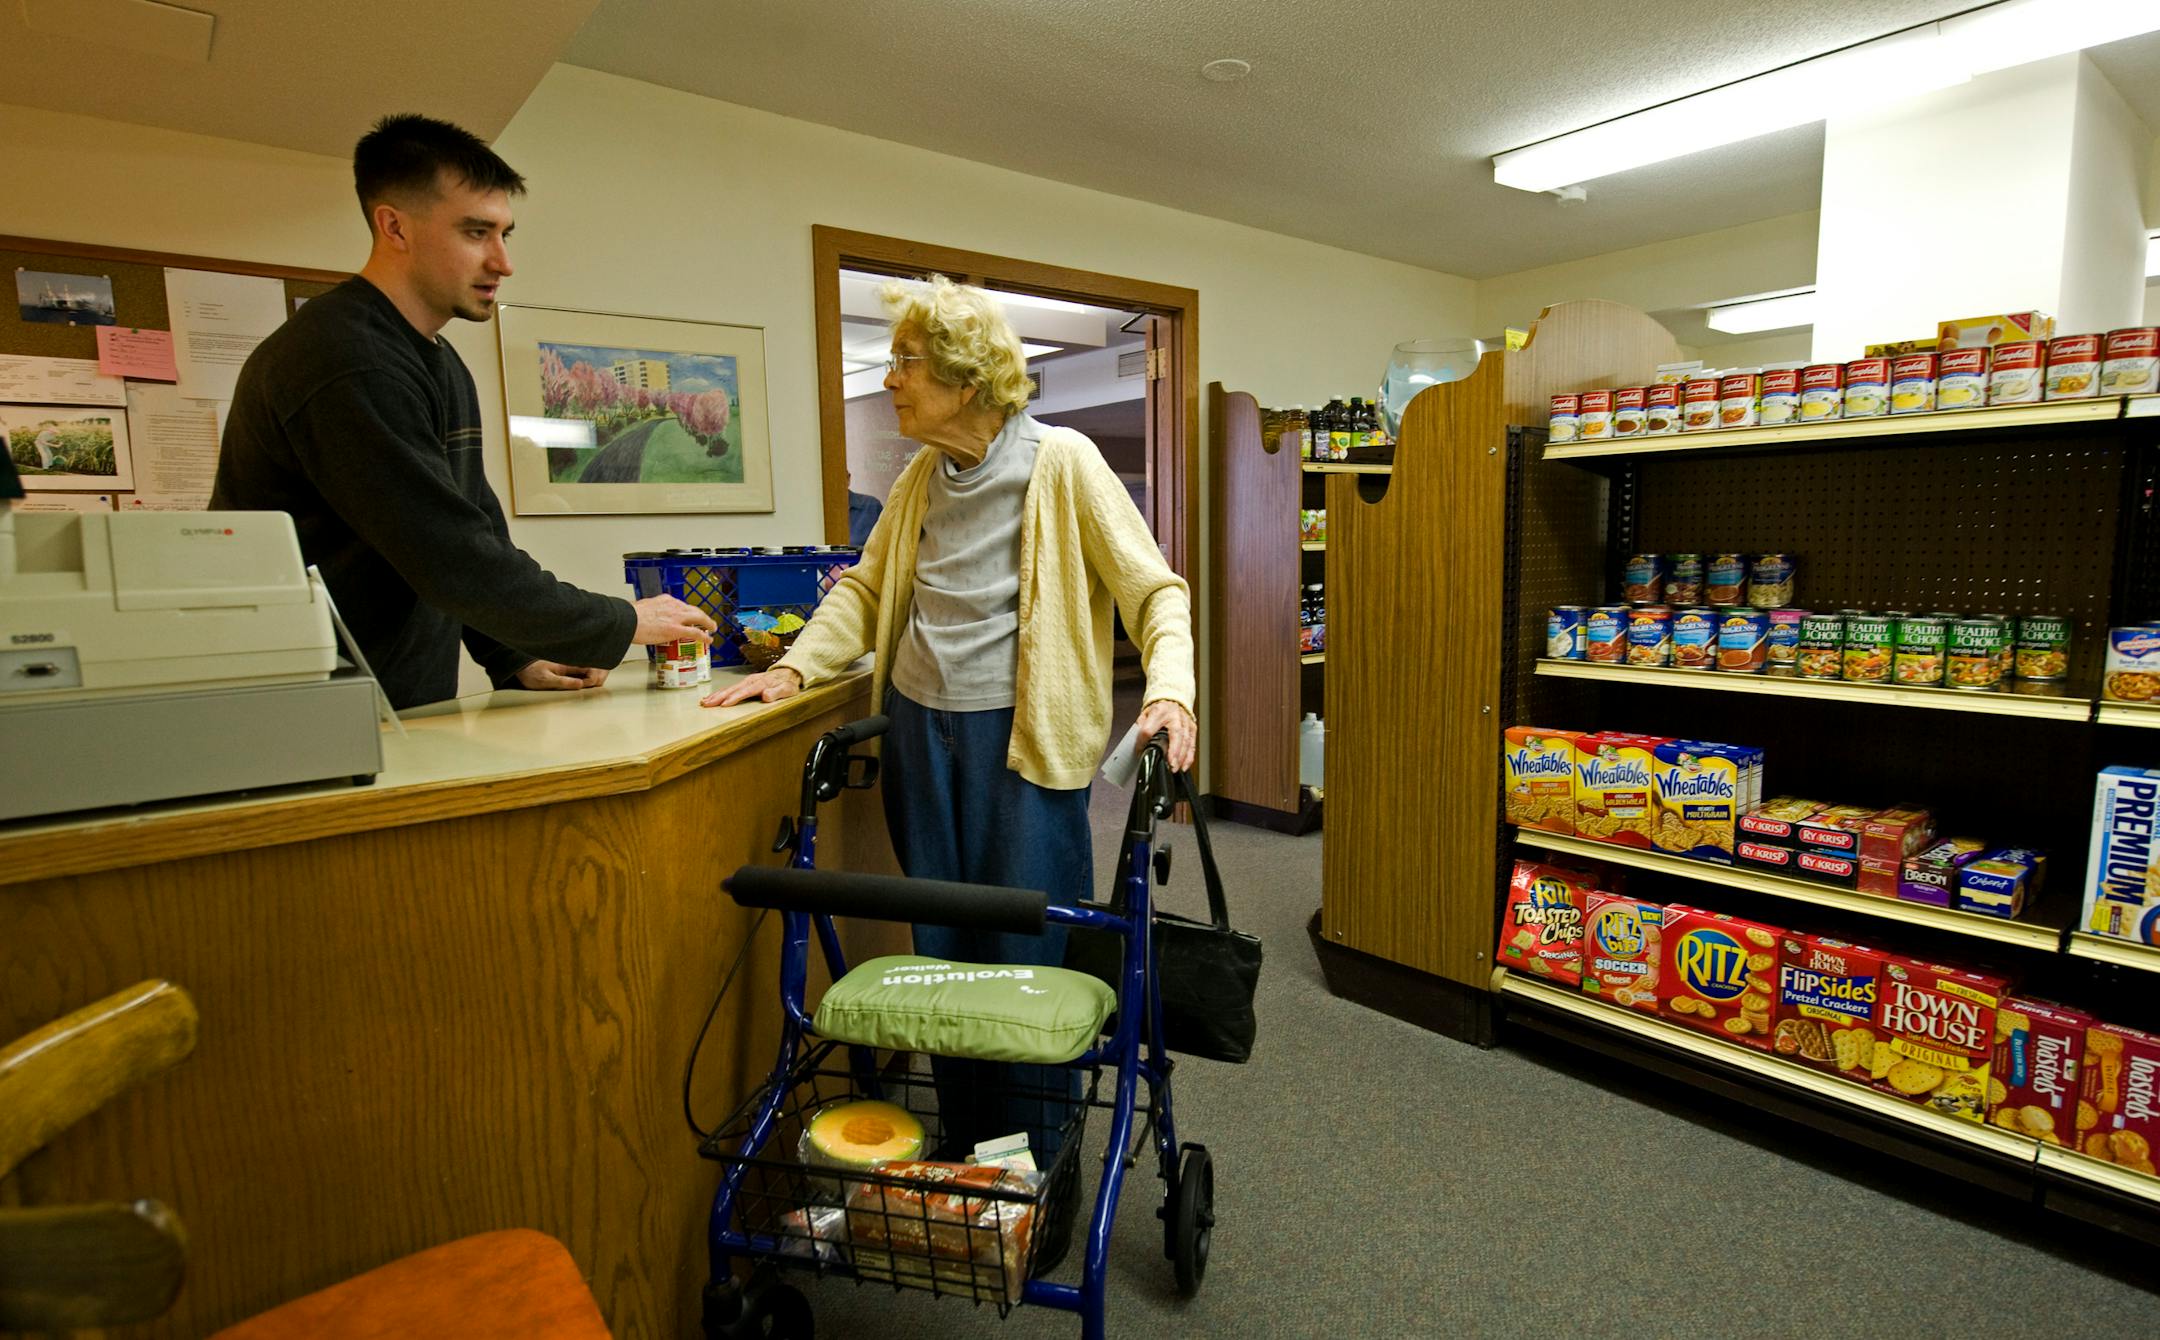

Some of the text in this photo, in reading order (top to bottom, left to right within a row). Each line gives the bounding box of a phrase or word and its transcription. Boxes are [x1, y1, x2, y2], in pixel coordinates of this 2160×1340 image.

[1803, 620, 1842, 631] HEALTHY
[1954, 625, 2000, 637] HEALTHY
[1507, 748, 1572, 777] Wheatables
[1577, 758, 1651, 788] Wheatables
[1655, 767, 1734, 799] Wheatables
[1743, 818, 1787, 834] RY KRISP
[1803, 830, 1849, 846] RY KRISP
[1742, 845, 1785, 861] RY KRISP
[2105, 779, 2158, 907] PREMIUM
[1801, 856, 1816, 867] RY
[1817, 860, 1848, 873] KRISP
[1514, 904, 1582, 926] TOASTED
[1601, 911, 1642, 938] RITZ
[1540, 922, 1584, 946] Chips
[1595, 958, 1648, 975] SOCCER
[1680, 934, 1750, 988] RITZ
[1809, 958, 1849, 976] HOUSE
[1812, 949, 1847, 968] TOWN
[882, 969, 1035, 986] Evolution
[1785, 990, 1869, 1015] Pretzel Crackers
[1891, 981, 1981, 1027] TOWN
[1882, 1003, 1986, 1051] HOUSE
[1900, 1042, 1959, 1069] ORIGINAL
[2033, 1034, 2072, 1098] Toasteds
